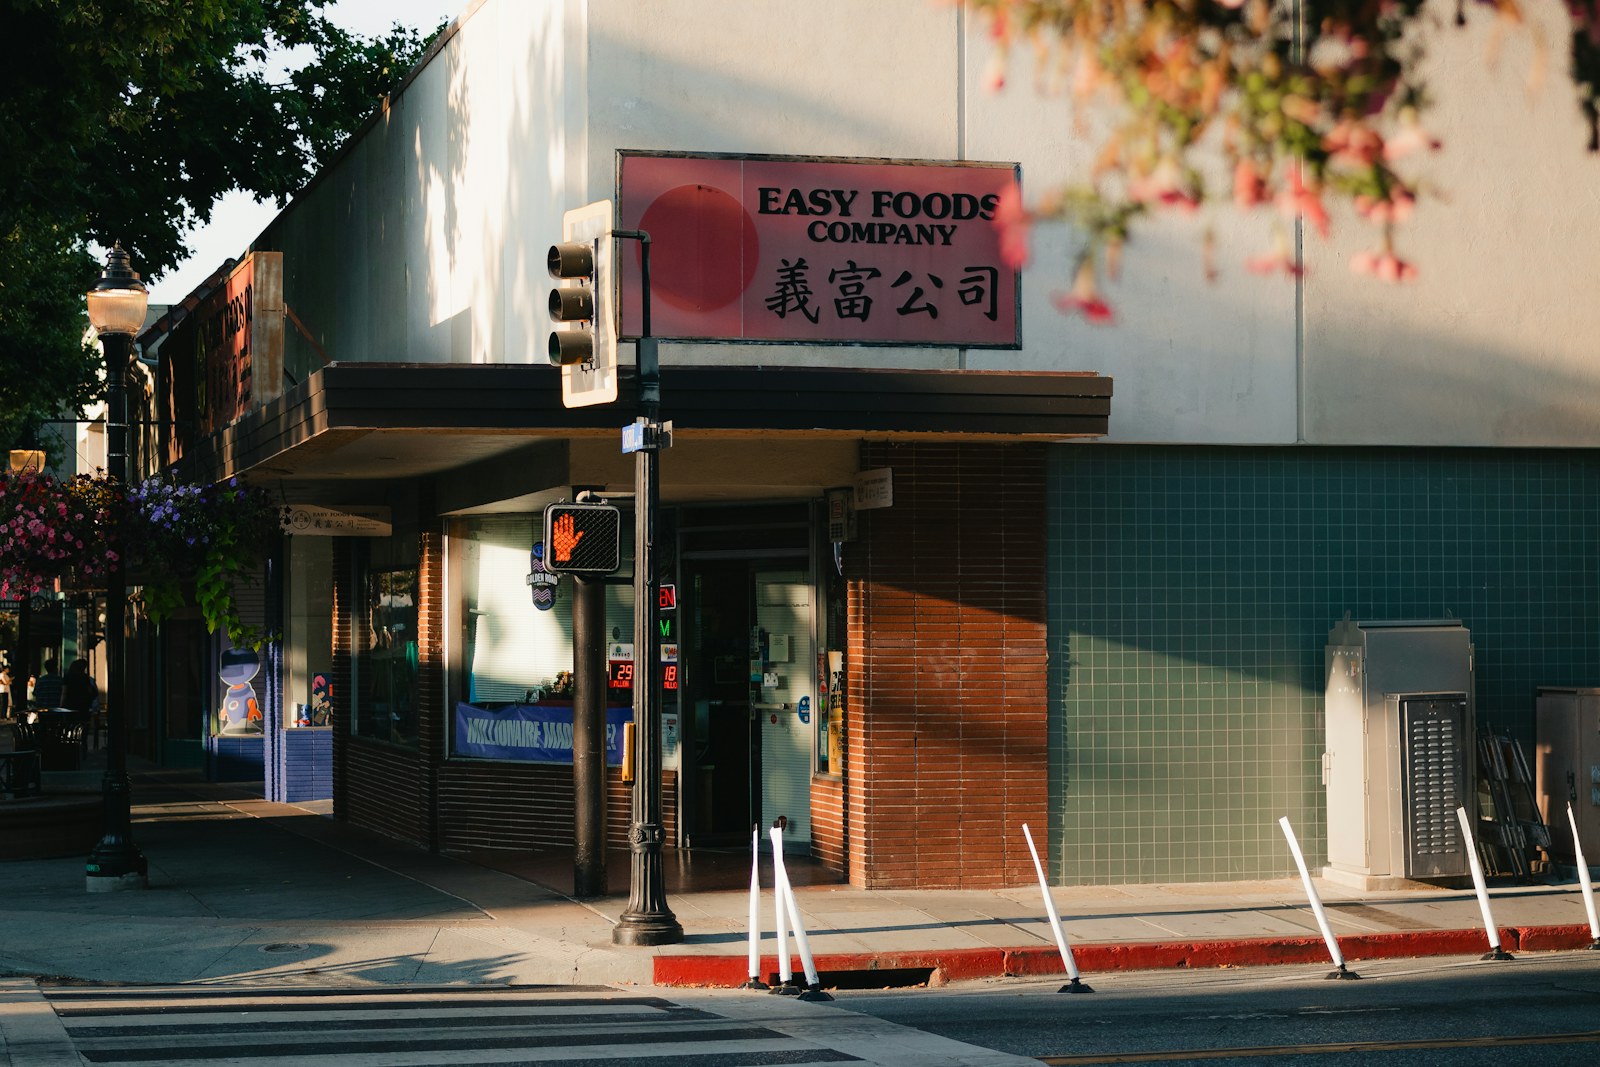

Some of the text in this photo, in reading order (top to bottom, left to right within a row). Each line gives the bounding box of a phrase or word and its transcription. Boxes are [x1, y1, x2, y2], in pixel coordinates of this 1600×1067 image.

[758, 188, 1000, 221] EASY FOODS
[807, 220, 957, 246] COMPANY
[765, 257, 999, 324] 義富公司
[663, 681, 679, 689] MILLIO
[467, 717, 541, 748] MILLIONAIRE
[542, 722, 574, 749] MAD
